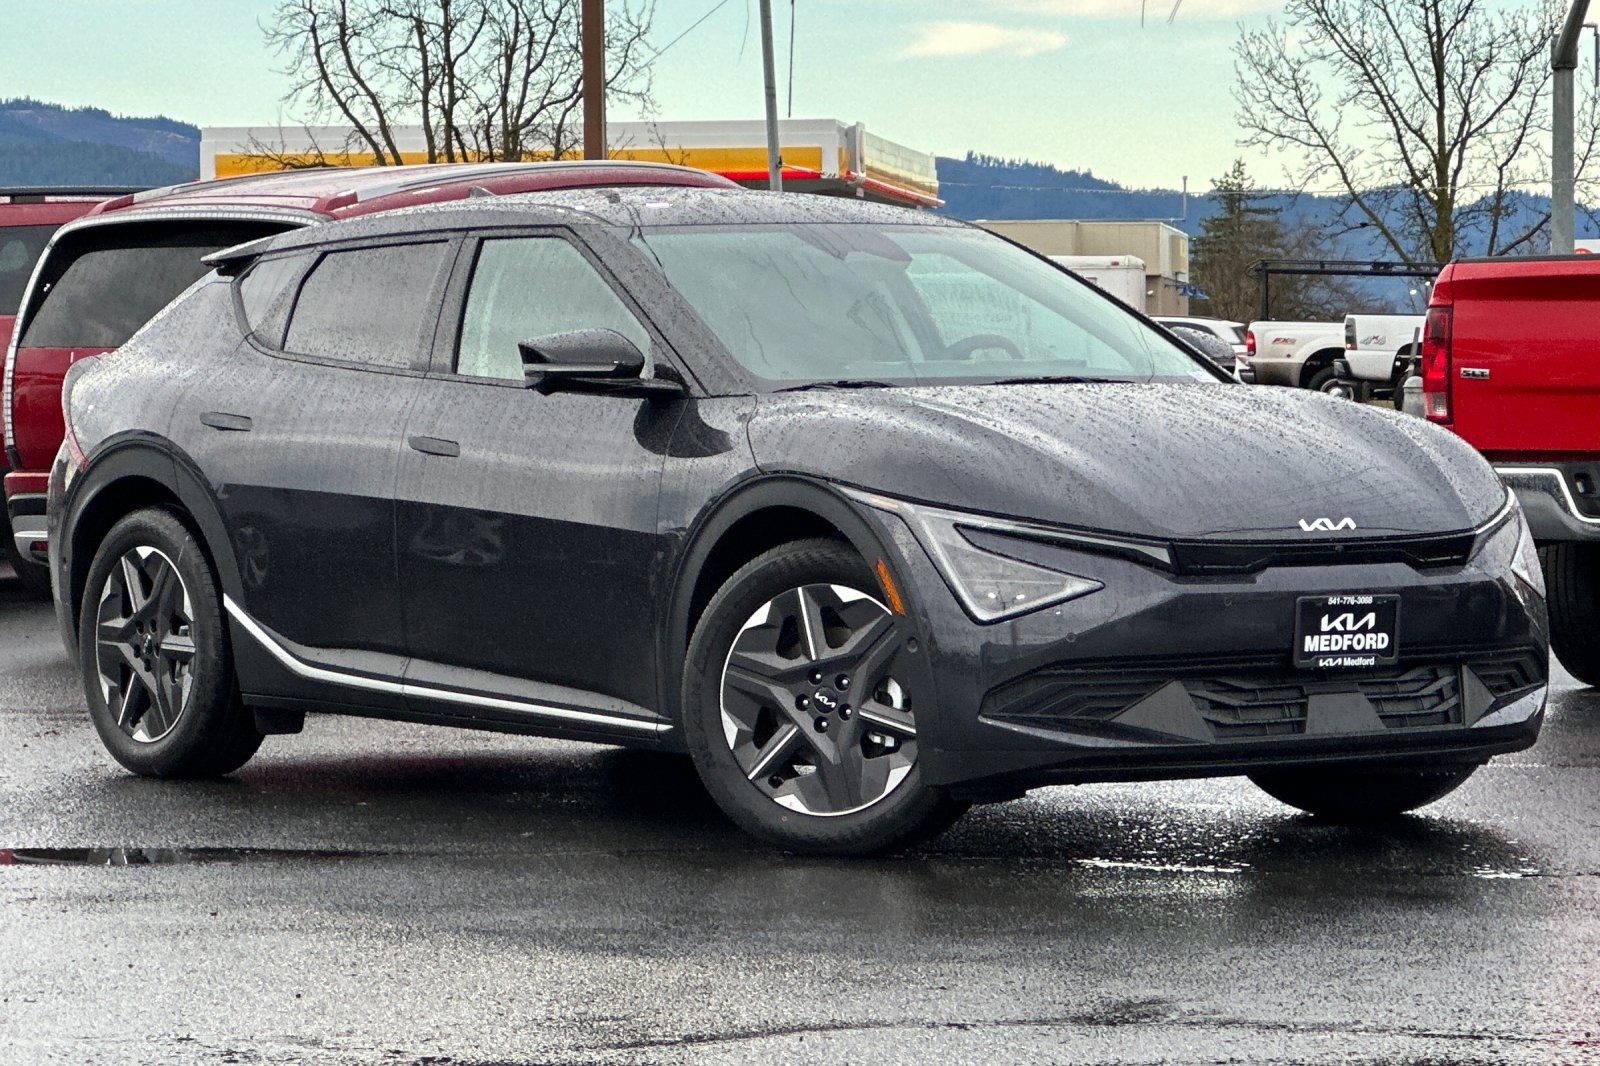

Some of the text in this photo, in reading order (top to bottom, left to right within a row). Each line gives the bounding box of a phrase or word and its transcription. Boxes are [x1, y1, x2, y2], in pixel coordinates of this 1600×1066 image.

[1298, 517, 1357, 532] KIA
[1321, 612, 1376, 632] KIA
[1304, 633, 1389, 652] MEDFORD
[1319, 656, 1375, 667] KIA Medford
